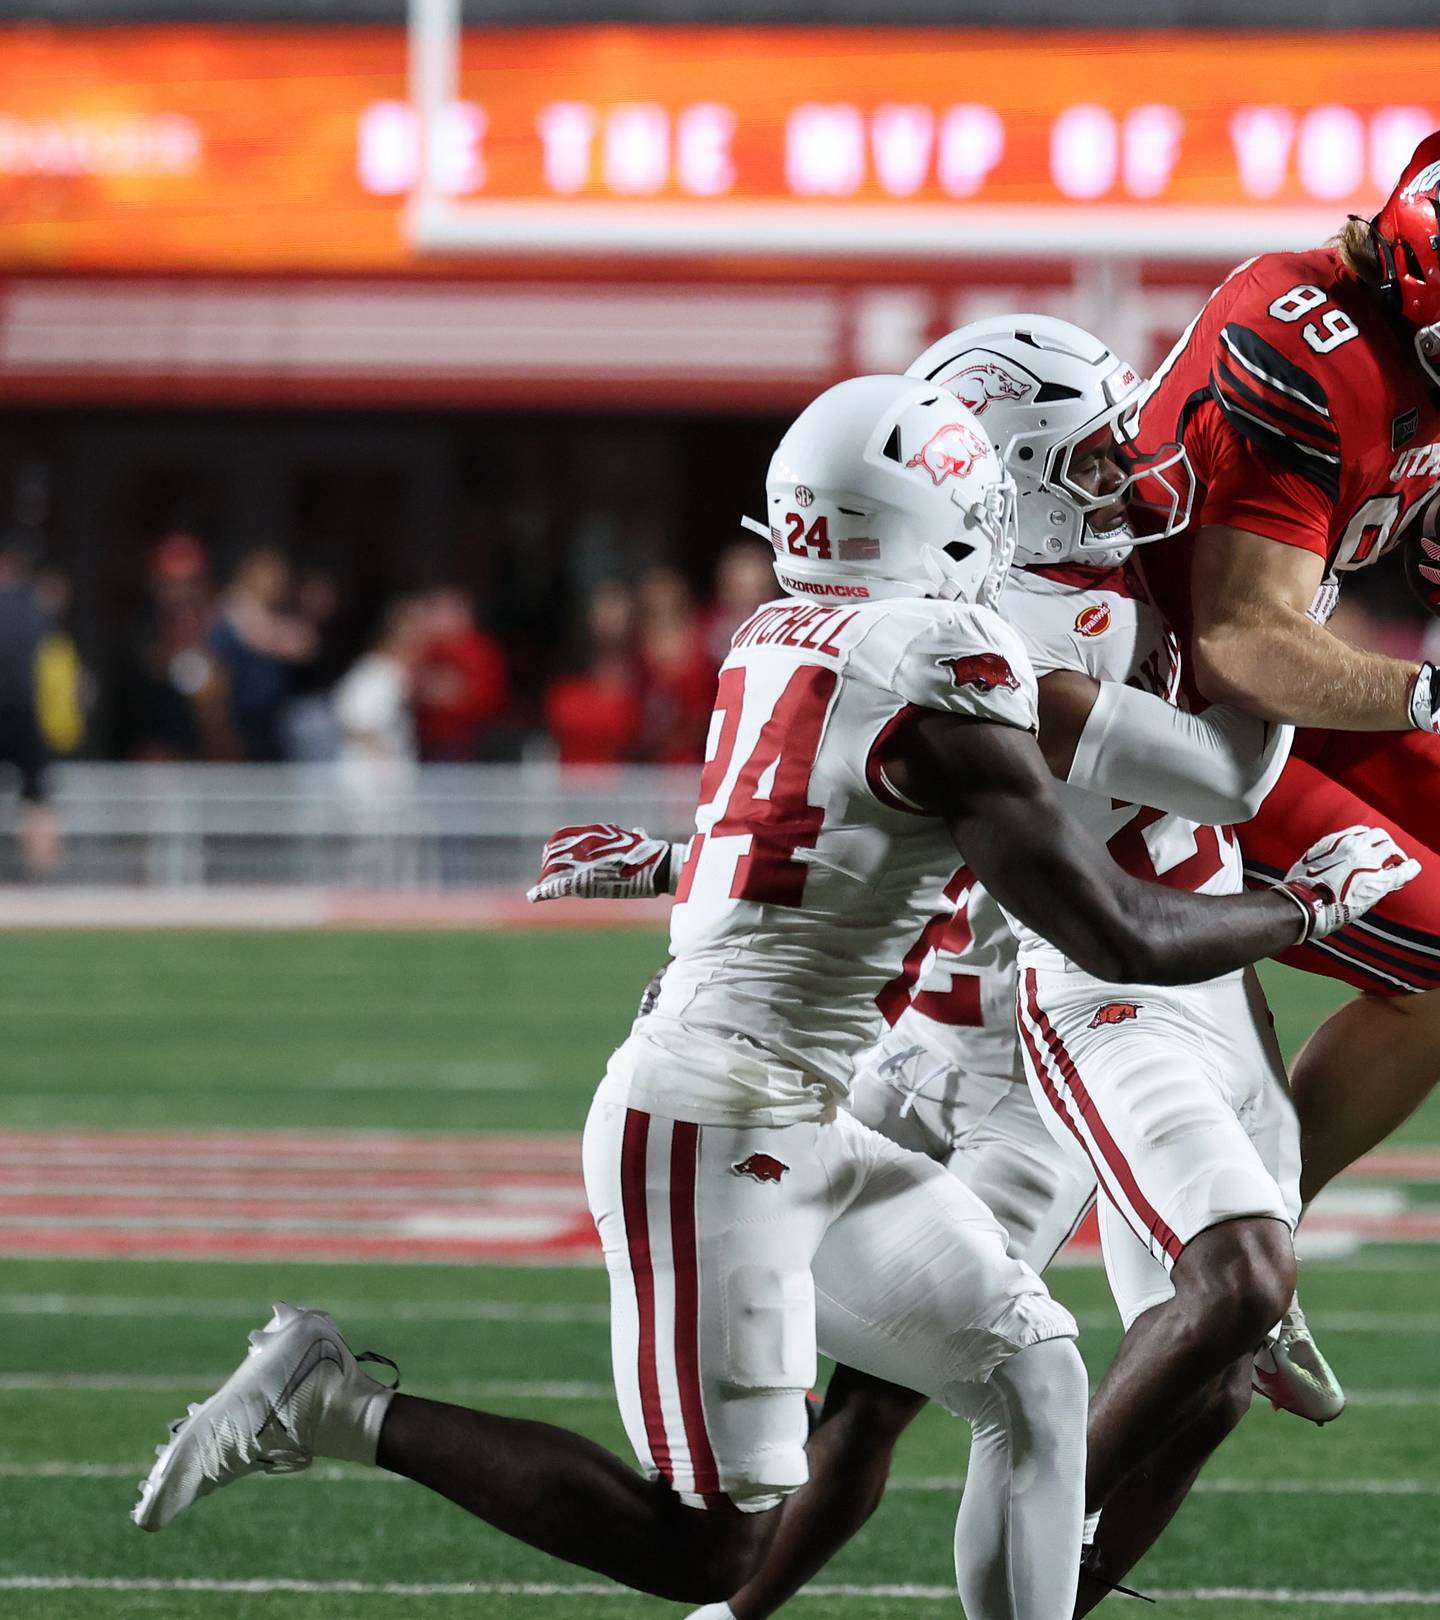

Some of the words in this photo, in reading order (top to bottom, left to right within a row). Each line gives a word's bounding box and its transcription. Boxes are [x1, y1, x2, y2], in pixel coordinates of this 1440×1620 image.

[536, 102, 736, 195] THE
[786, 102, 1004, 198] MVP
[1050, 103, 1183, 198] OF
[1268, 284, 1359, 354] 89
[785, 512, 832, 559] 24
